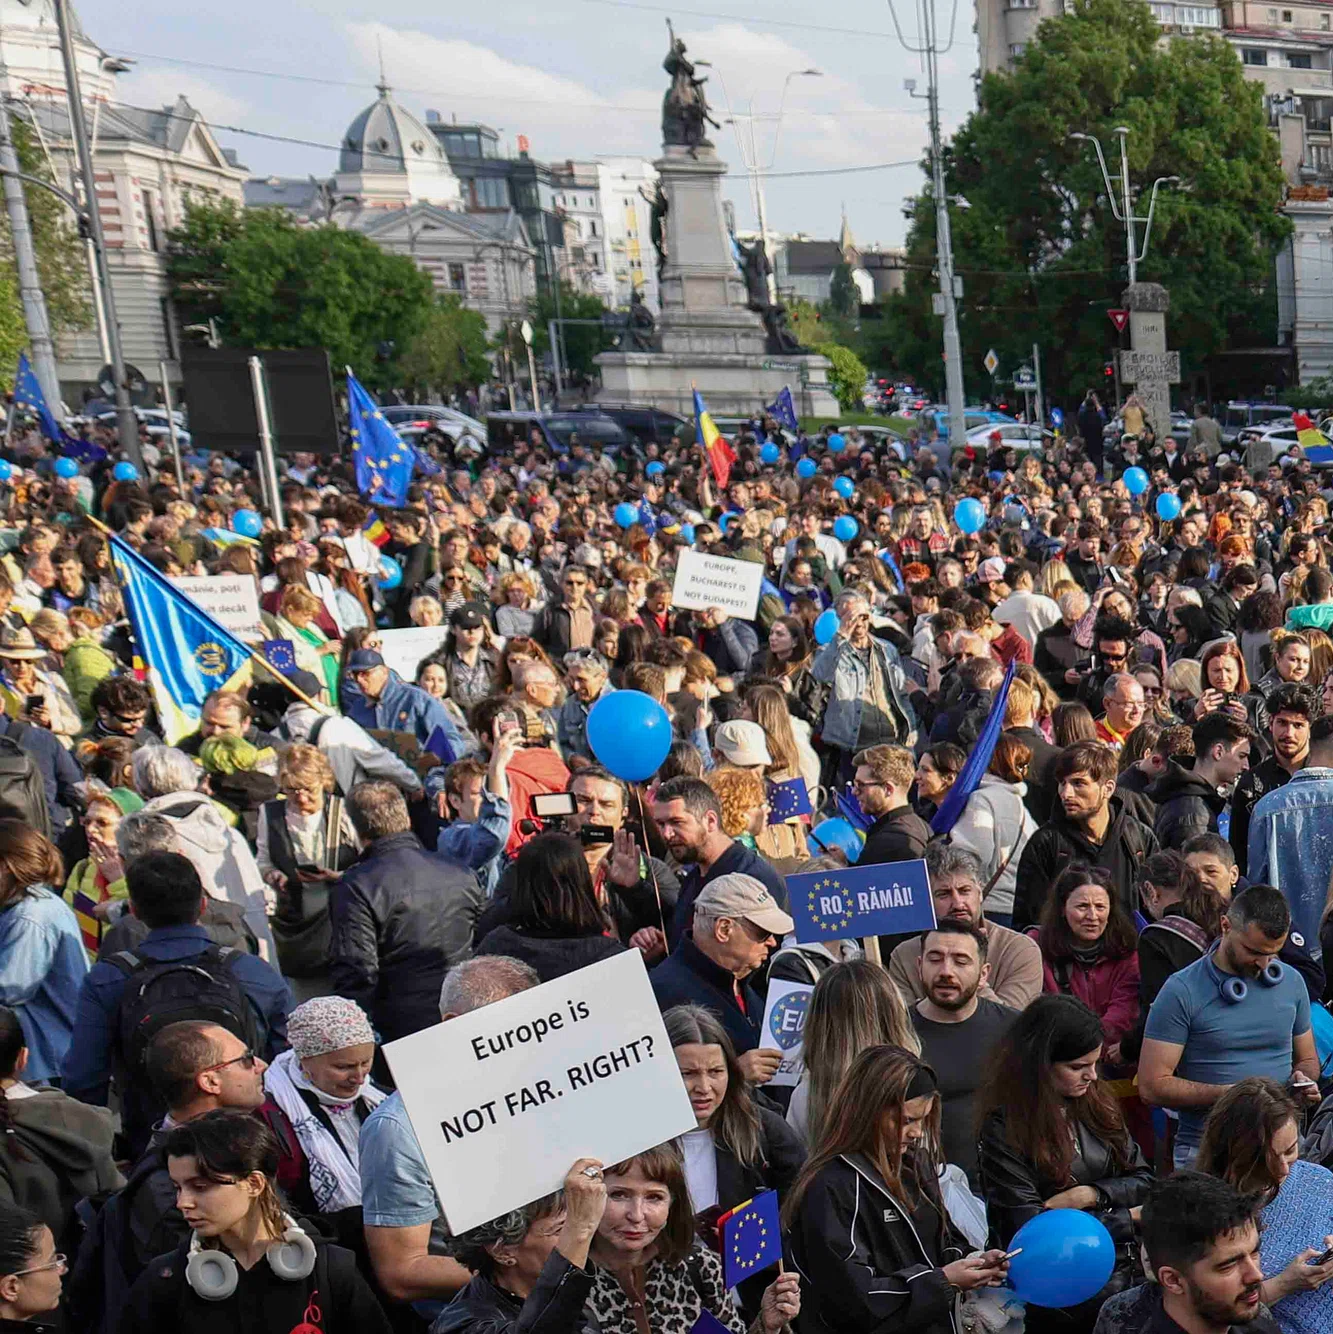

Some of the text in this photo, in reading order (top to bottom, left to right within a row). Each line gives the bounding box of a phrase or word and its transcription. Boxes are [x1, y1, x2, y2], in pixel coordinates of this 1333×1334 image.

[684, 590, 701, 599] NOT
[690, 575, 746, 592] BUCHAREST IS
[471, 999, 590, 1061] Europe is
[440, 1035, 655, 1143] NOT FAR. RIGHT?
